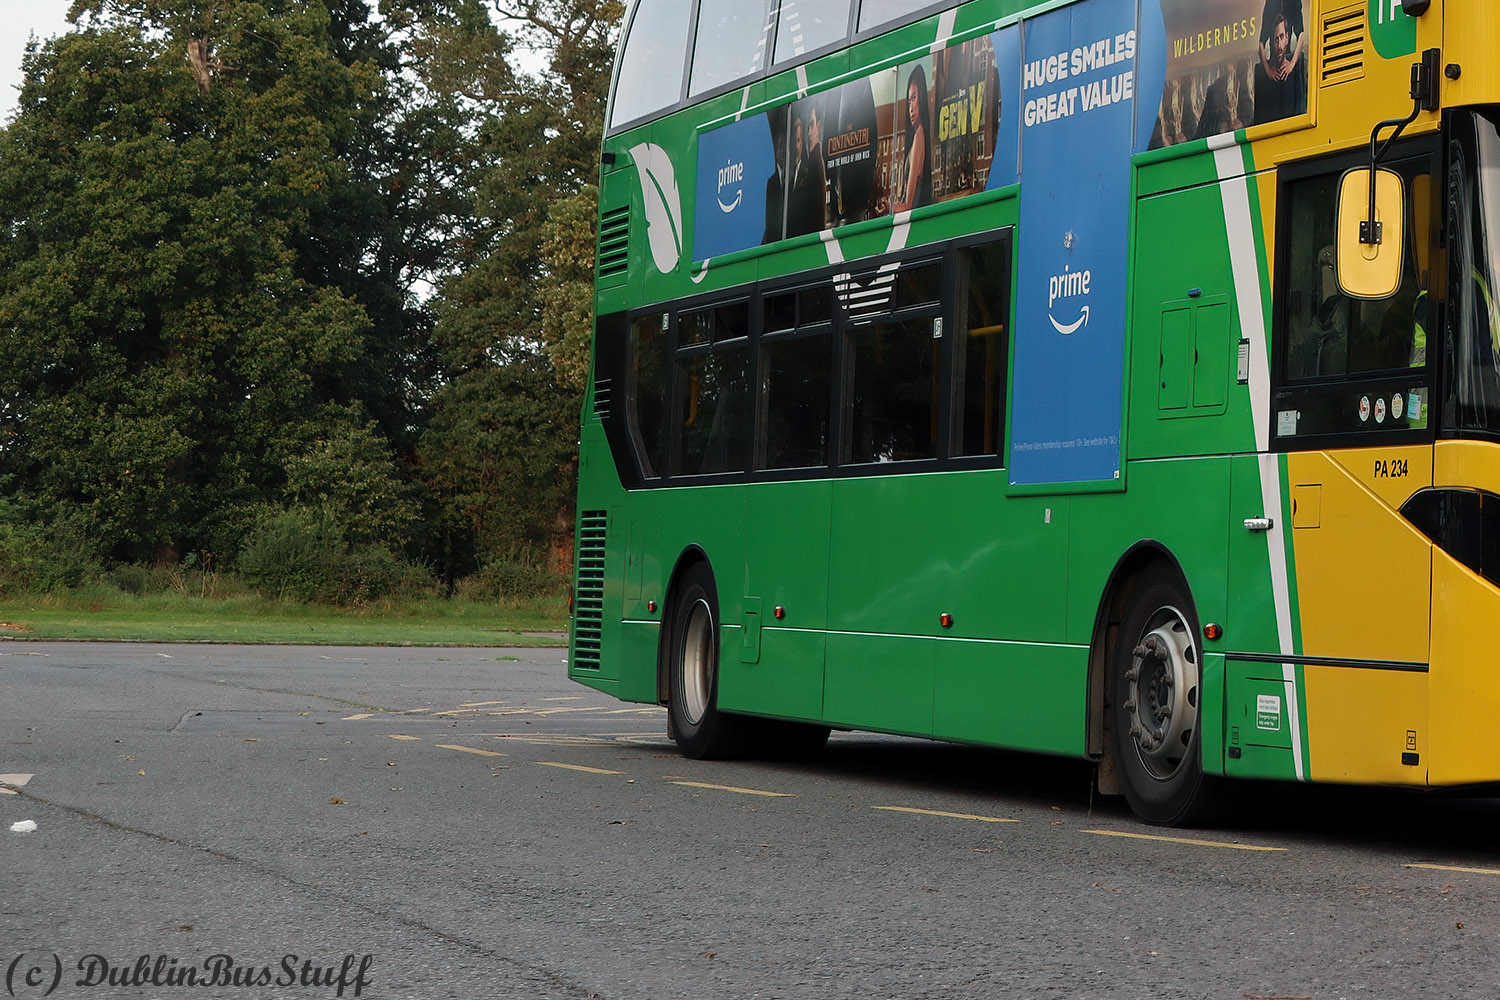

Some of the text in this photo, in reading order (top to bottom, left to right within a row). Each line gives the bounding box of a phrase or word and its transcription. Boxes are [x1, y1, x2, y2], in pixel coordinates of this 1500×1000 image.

[1173, 16, 1256, 58] WILDERNESS
[1024, 30, 1136, 90] HUGE SMILES
[939, 81, 985, 142] GEN V
[1024, 71, 1133, 127] GREAT VALUE
[718, 159, 744, 194] prime
[1049, 265, 1091, 308] prime
[1374, 459, 1408, 478] PA 234
